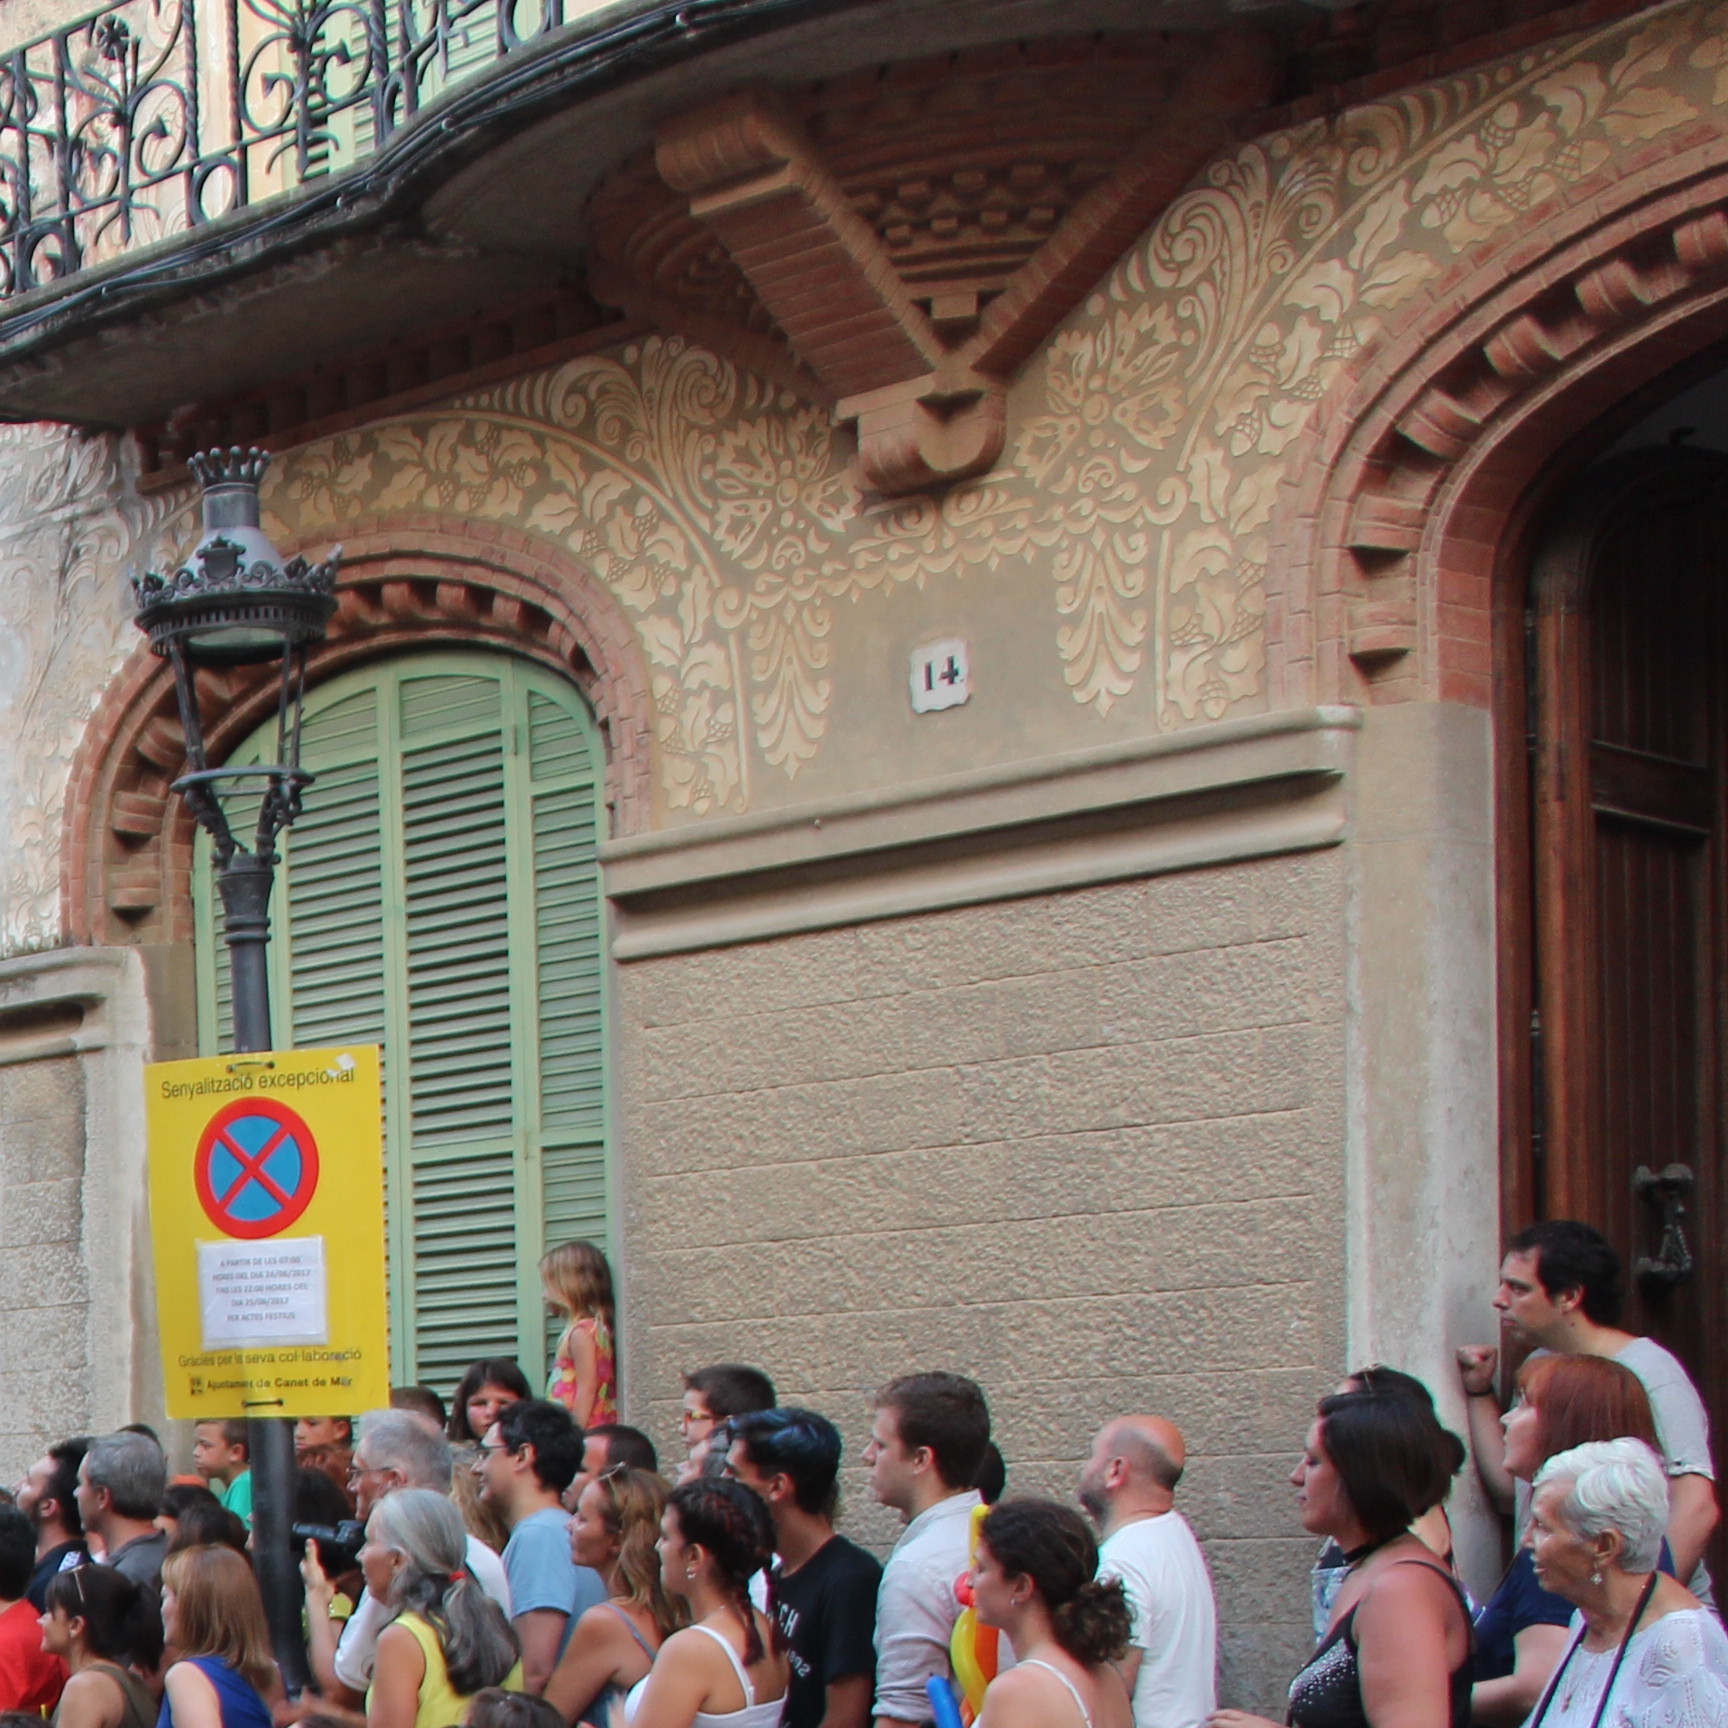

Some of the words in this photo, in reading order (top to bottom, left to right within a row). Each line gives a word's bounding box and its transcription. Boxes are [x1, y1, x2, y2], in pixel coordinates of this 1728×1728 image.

[924, 655, 959, 692] 14
[161, 1073, 253, 1100] Senyalització
[217, 1353, 233, 1368] per
[245, 1353, 275, 1364] seva
[256, 1379, 270, 1388] de
[274, 1377, 308, 1388] Canet
[311, 1377, 326, 1387] de
[330, 1377, 353, 1387] Mar
